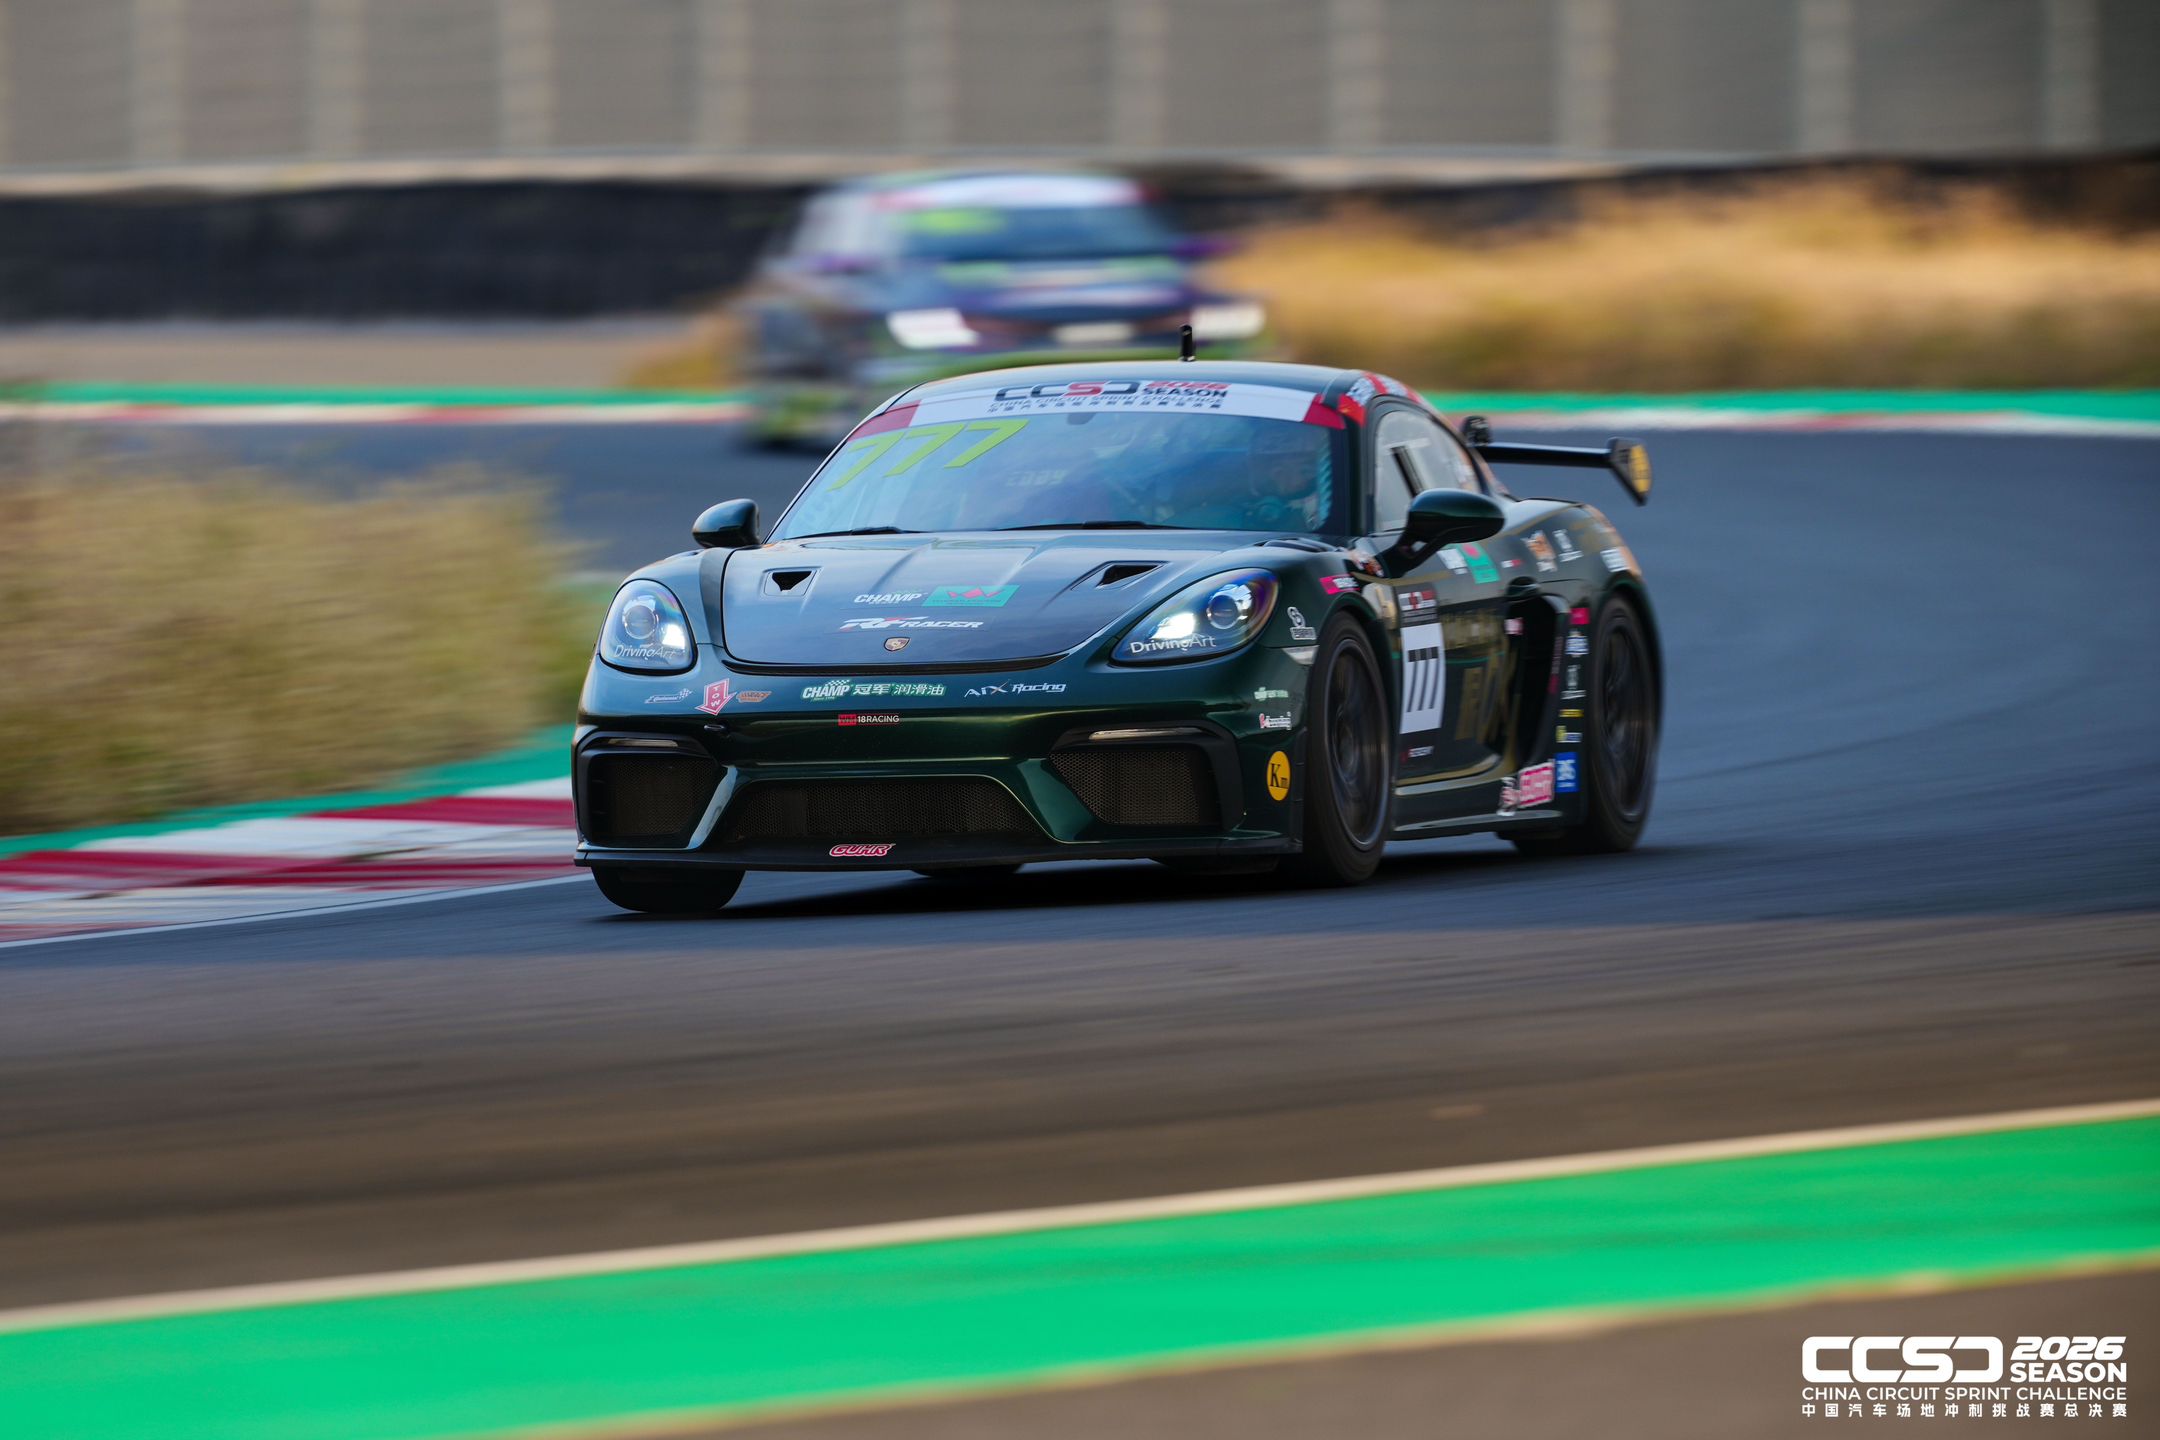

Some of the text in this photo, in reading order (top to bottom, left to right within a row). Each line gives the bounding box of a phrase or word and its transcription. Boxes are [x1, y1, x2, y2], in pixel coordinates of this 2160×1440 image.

[1143, 387, 1227, 398] SEASON
[826, 419, 1030, 492] 777
[854, 592, 923, 604] CHAMP
[1130, 633, 1216, 653] DrivingArt
[614, 644, 677, 660] DrivingArt
[1407, 646, 1439, 712] 777
[711, 685, 721, 707] TOW
[802, 683, 850, 698] CHAMP
[1011, 683, 1067, 694] Racing
[830, 844, 891, 856] GUHR
